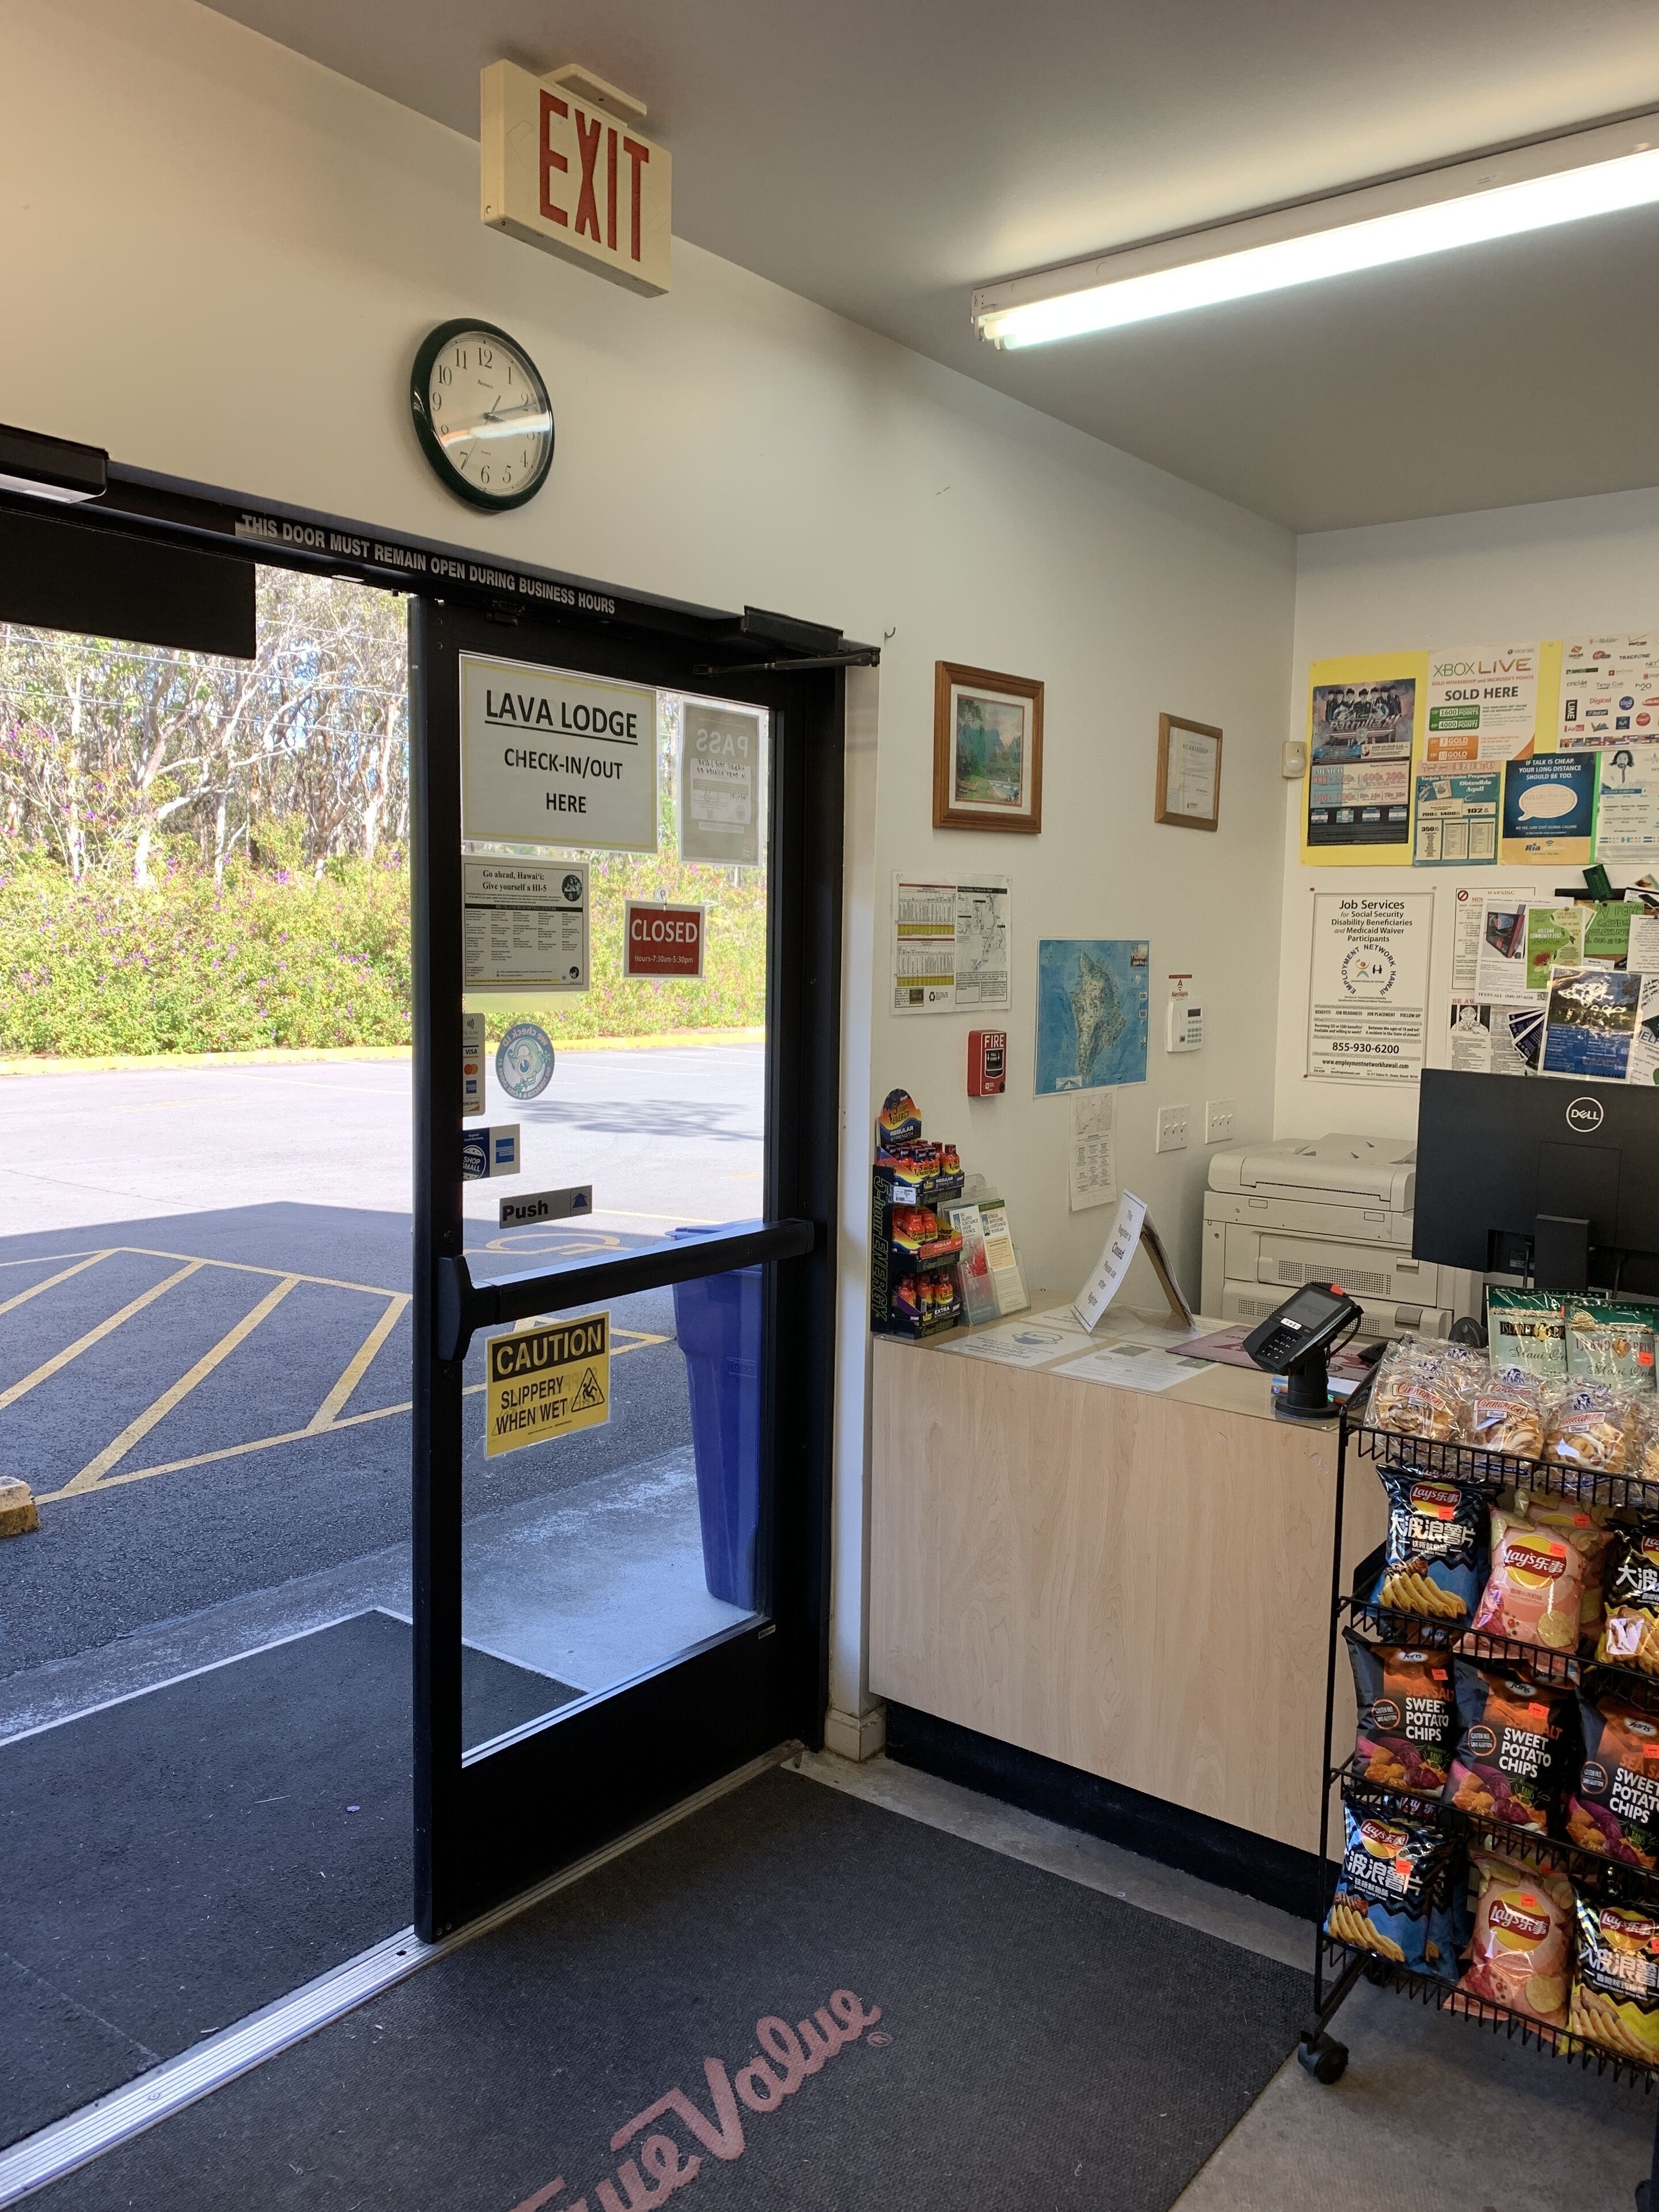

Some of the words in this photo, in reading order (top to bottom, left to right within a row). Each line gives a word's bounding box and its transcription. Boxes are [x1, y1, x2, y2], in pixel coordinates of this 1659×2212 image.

[539, 89, 650, 262] EXIT
[455, 349, 467, 369] 11
[478, 347, 492, 369] 12
[438, 365, 452, 386] 10
[508, 366, 512, 384] 1
[432, 392, 442, 411] 9
[460, 452, 468, 470] 7
[520, 450, 528, 468] 4
[481, 465, 490, 483] 6
[503, 465, 512, 483] 5
[242, 514, 278, 539] THIS
[283, 522, 325, 548] DOOR
[330, 531, 370, 558] MUST
[374, 544, 426, 571] REMAIN
[430, 558, 466, 579] OPEN
[469, 565, 516, 591] DURING
[519, 578, 575, 606] BUSINESS
[578, 593, 615, 614] HOURS
[1433, 662, 1475, 677] XBOX
[1478, 658, 1532, 674] LIVE
[1445, 689, 1479, 701] SOLD
[1484, 686, 1518, 699] HERE
[486, 690, 554, 726] LAVA
[561, 703, 637, 739] LODGE
[504, 748, 623, 780] CHECK-IN/OUT
[546, 793, 586, 813] HERE
[494, 870, 516, 880] ahead,
[483, 882, 498, 890] Give
[500, 884, 525, 892] yourself
[1339, 900, 1358, 909] Job
[1361, 900, 1404, 909] Services
[1374, 911, 1404, 919] Security
[631, 919, 698, 944] CLOSED
[1341, 946, 1359, 994] EMPLOYMENT
[1364, 944, 1396, 967] NETWORK
[1380, 971, 1396, 995] HAWAII
[984, 1035, 1004, 1048] FIRE
[1332, 1043, 1399, 1054] 855-930-6200
[1322, 1059, 1409, 1069] www.employmentnetworkhawaii.com
[893, 1111, 910, 1124] ENERGY
[1571, 1109, 1600, 1120] DELL
[890, 1126, 914, 1137] REGULAR
[891, 1132, 914, 1141] STRENGTH
[463, 1156, 480, 1165] SHOP
[502, 1200, 548, 1222] Push
[873, 1176, 891, 1235] 5-hour
[934, 1241, 952, 1249] REGULAR
[1112, 1241, 1126, 1260] Closed
[872, 1234, 888, 1322] ENERGY
[934, 1306, 950, 1315] EXTRA
[1502, 1323, 1531, 1335] ISLAND
[497, 1324, 601, 1375] CAUTION
[501, 1376, 564, 1410] SLIPPERY
[1397, 1382, 1443, 1408] Cinnamon
[1478, 1398, 1524, 1415] Cinnamon
[496, 1407, 536, 1435] WHEN
[540, 1398, 567, 1422] WET
[1412, 1487, 1436, 1500] Lay's
[1437, 1492, 1459, 1503] 乐事
[1389, 1514, 1476, 1548] 大波浪薯片
[1506, 1550, 1536, 1567] Lay's
[1533, 1557, 1565, 1573] 乐事
[1406, 1698, 1446, 1713] SWEET
[1406, 1712, 1449, 1727] POTATO
[1406, 1726, 1441, 1741] CHIPS
[1503, 1728, 1548, 1751] SWEET
[1501, 1741, 1551, 1767] POTATO
[1499, 1756, 1538, 1778] CHIPS
[1609, 1798, 1650, 1823] CHIPS
[1362, 1823, 1387, 1839] Lay's
[1490, 1906, 1518, 1926] Lay's
[1517, 1916, 1548, 1934] 乐事
[1603, 1912, 1626, 1929] Lay's
[609, 1988, 882, 2161] Value
